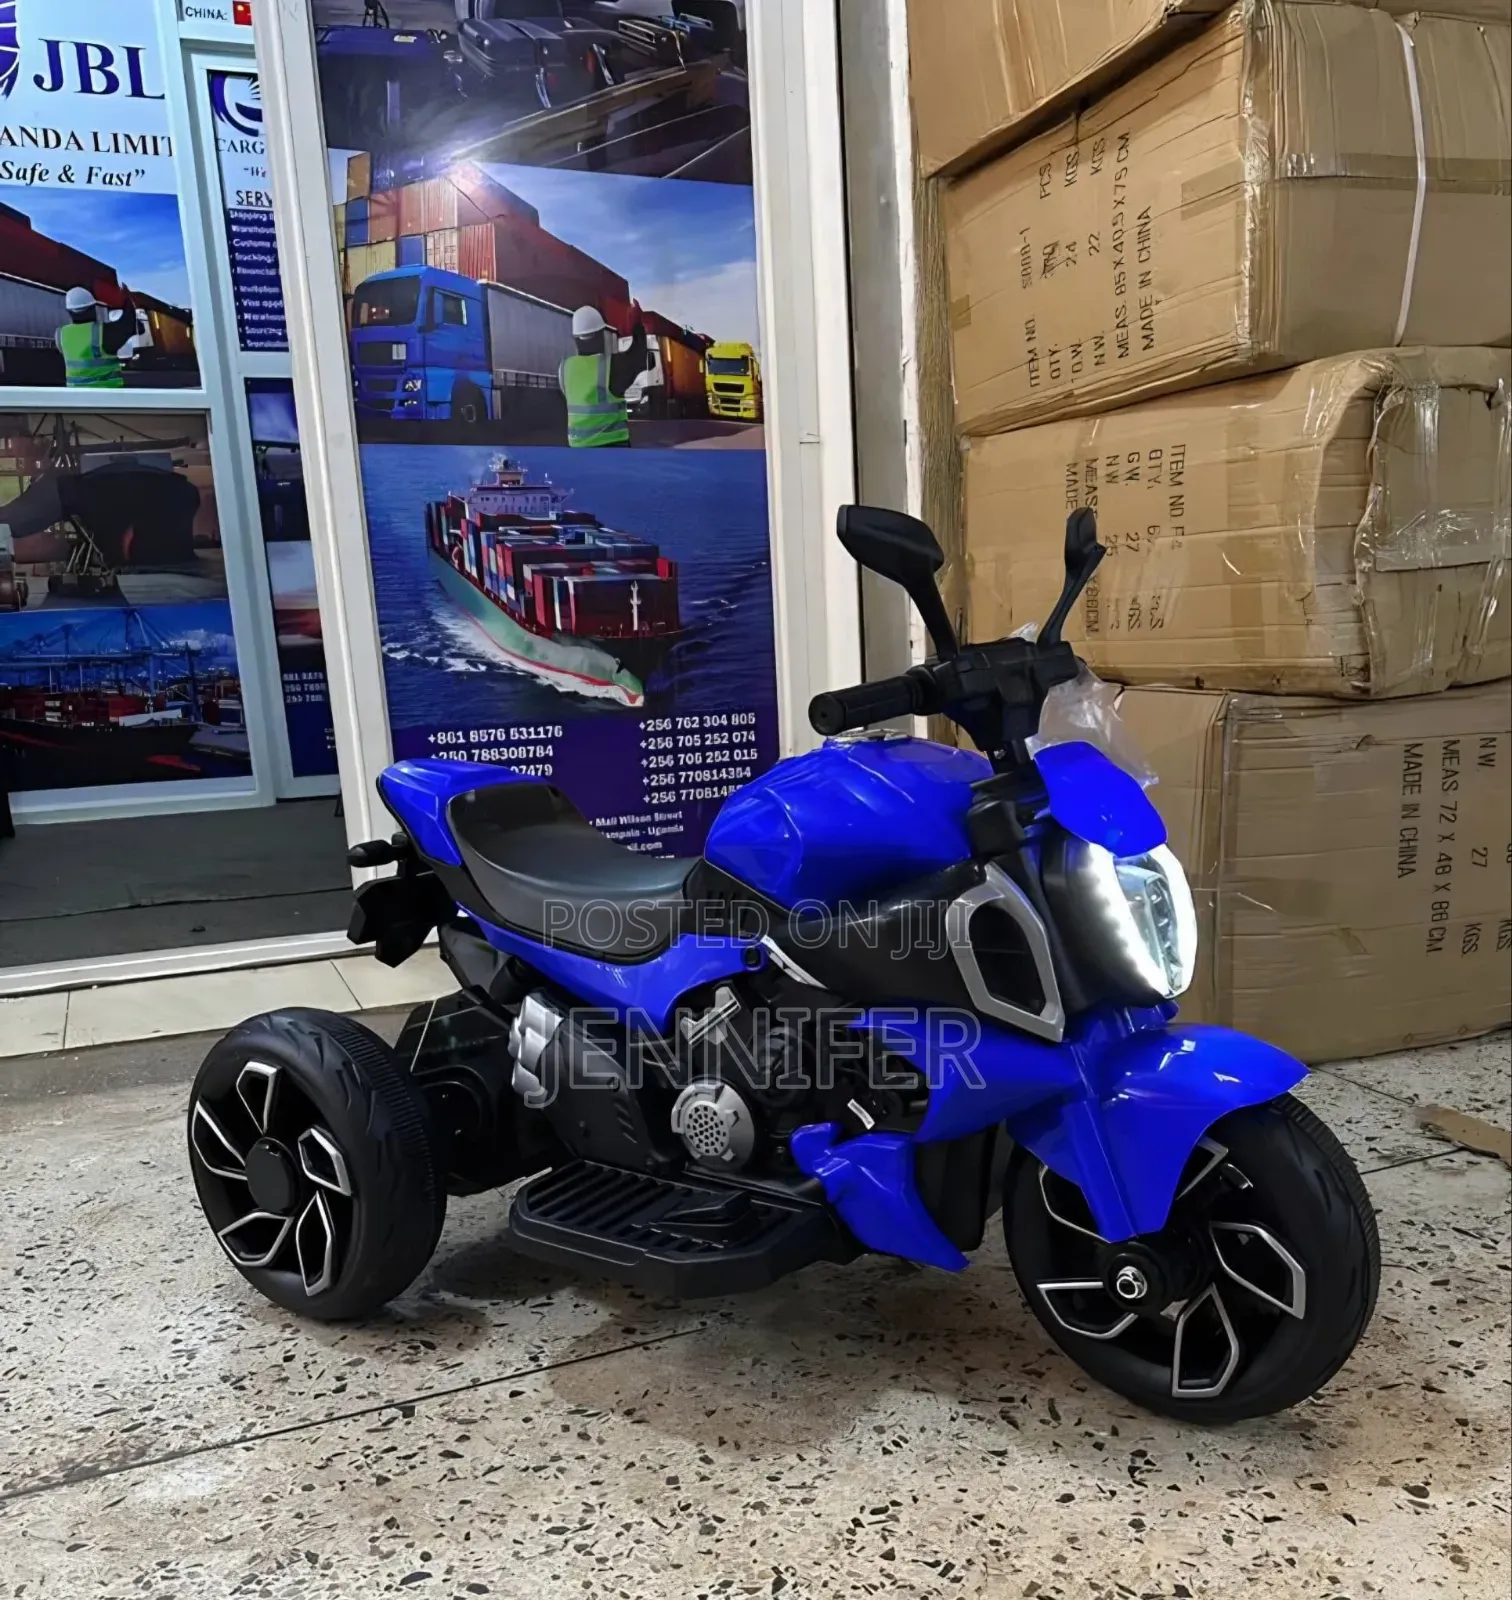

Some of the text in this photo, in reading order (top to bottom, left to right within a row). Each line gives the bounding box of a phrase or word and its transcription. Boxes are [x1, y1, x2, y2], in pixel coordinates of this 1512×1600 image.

[33, 38, 165, 100] JBL
[0, 160, 49, 187] Safe
[58, 165, 75, 184] &
[1136, 205, 1154, 352] MADE IN CHINA
[1028, 347, 1041, 388] ITEM
[1169, 443, 1186, 487] ITEM
[1066, 462, 1079, 510] MADE
[639, 718, 672, 731] +256
[676, 716, 700, 730] 762
[703, 714, 728, 728] 304
[640, 737, 673, 750] +256
[677, 735, 701, 748] 705
[704, 732, 729, 745] 252
[641, 755, 675, 768] +256
[643, 791, 676, 804] +256
[1398, 742, 1423, 879] MADE IN CHINA
[1439, 800, 1457, 824] 72
[1437, 831, 1455, 843] X
[1471, 846, 1488, 868] 27
[1434, 881, 1451, 893] X
